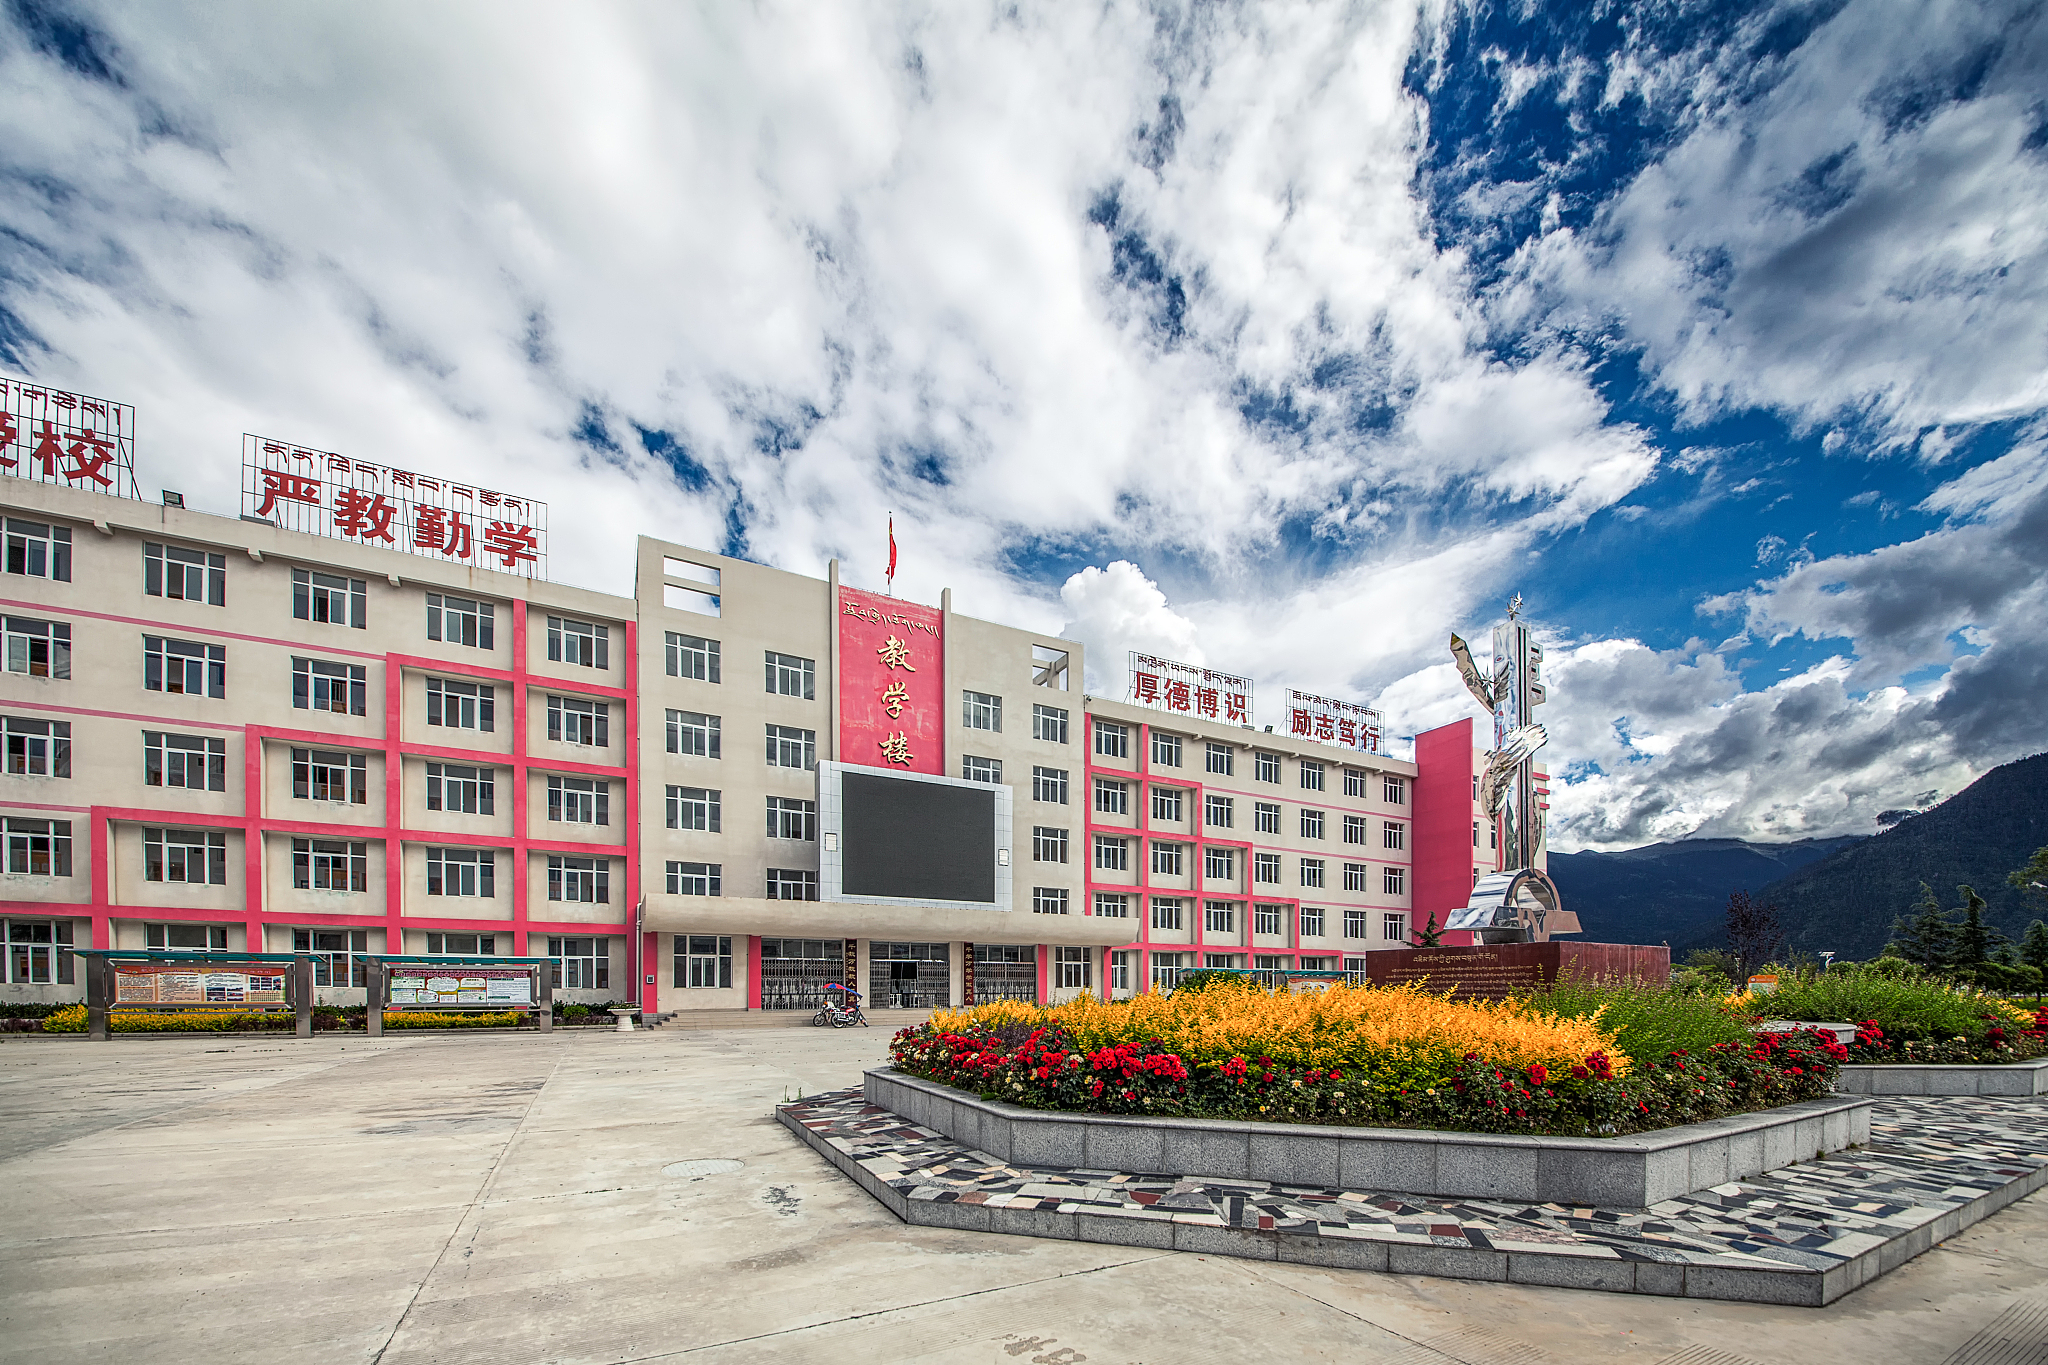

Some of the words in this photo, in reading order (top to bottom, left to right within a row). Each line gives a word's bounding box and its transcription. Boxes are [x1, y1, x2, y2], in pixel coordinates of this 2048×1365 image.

[0, 411, 115, 487] 校
[256, 468, 538, 567] 严教勤学
[876, 634, 917, 767] 教学楼
[1134, 671, 1248, 724] 厚德博识
[1291, 708, 1380, 752] 励志笃行
